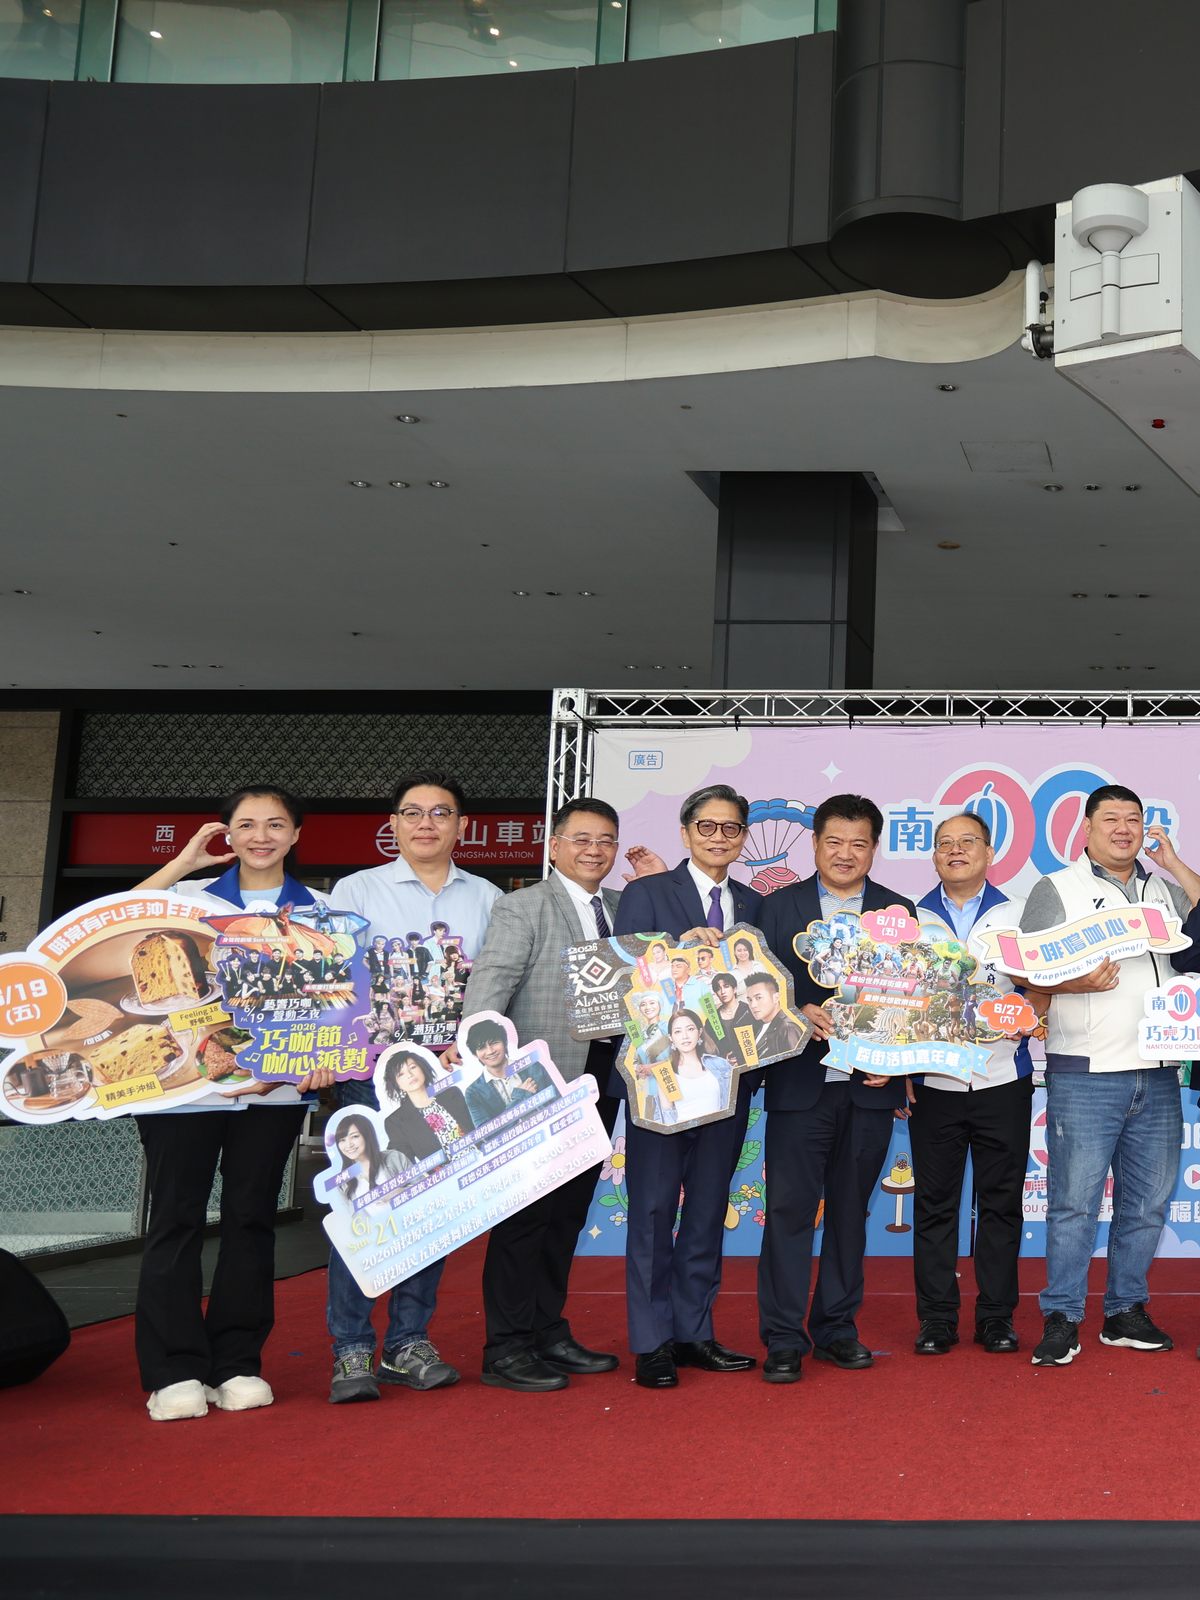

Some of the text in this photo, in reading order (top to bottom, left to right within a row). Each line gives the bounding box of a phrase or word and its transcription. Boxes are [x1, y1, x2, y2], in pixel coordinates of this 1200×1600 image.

[633, 753, 658, 767] 廣告
[156, 825, 175, 842] 西
[889, 807, 934, 851] 南
[152, 845, 176, 854] WEST
[499, 851, 534, 859] STATION
[171, 903, 217, 920] 主題
[48, 902, 164, 957] 啡常有FU手沖
[876, 915, 906, 930] 6/19
[881, 927, 898, 938] (五)
[1039, 918, 1129, 963] 啡嚐咖心
[568, 943, 598, 955] 2026
[1034, 964, 1084, 981] Happiness:
[1086, 955, 1104, 967] Now
[575, 991, 618, 1008] ALANG
[1152, 996, 1166, 1011] 南
[6, 1005, 41, 1026] (五)
[180, 1006, 218, 1021] Feeling 18
[994, 1003, 1023, 1016] 6/27
[291, 1023, 316, 1031] 2026
[999, 1014, 1015, 1025] (六)
[260, 1026, 342, 1052] 巧咖節
[394, 1030, 413, 1043] 6/
[423, 1034, 458, 1044] 星動之
[262, 1048, 369, 1076] 咖心派對
[855, 1046, 960, 1068] 踩街活動嘉年華
[105, 1081, 157, 1101] 精美手沖組
[531, 1126, 597, 1170] 14:00-17:30
[534, 1149, 598, 1194] 18:30-20:30
